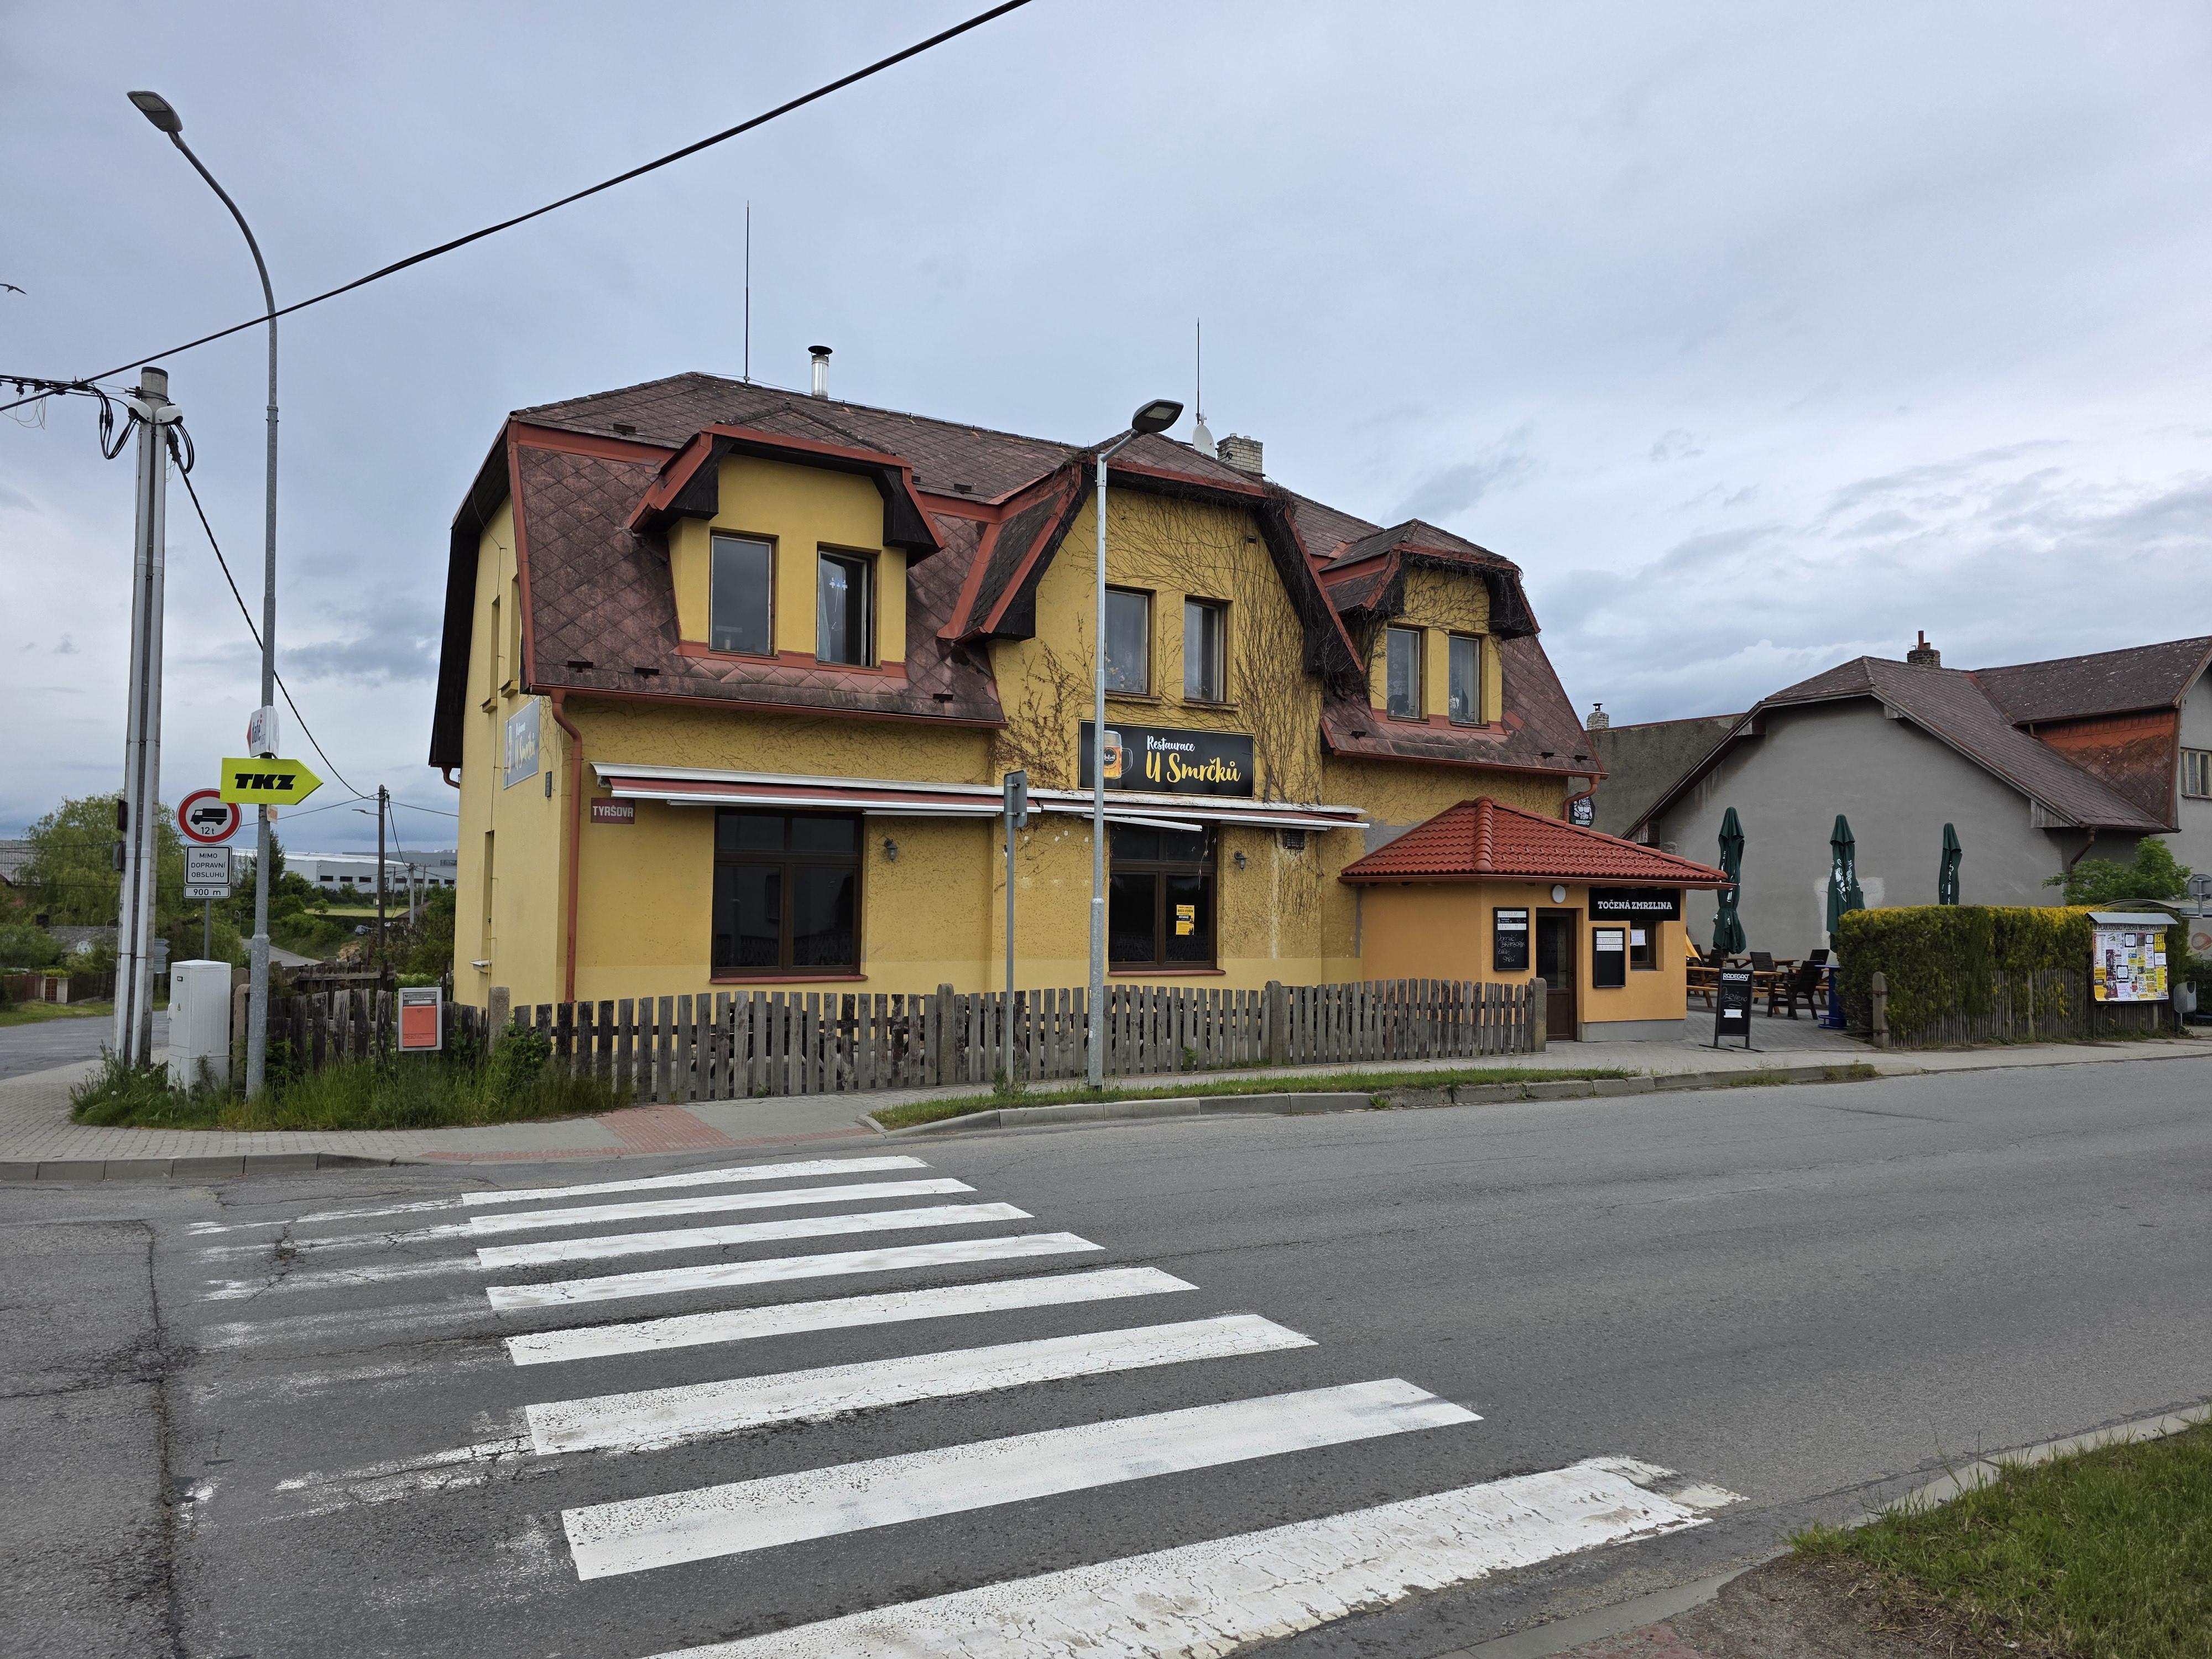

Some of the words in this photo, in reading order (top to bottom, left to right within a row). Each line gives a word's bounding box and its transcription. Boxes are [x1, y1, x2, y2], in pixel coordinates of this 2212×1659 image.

[1146, 735, 1196, 752] Restaurace
[1146, 750, 1160, 782] U
[1166, 752, 1241, 783] Smrčků
[234, 773, 296, 790] TKZ
[592, 805, 634, 817] TYRŠOVA
[1598, 899, 1631, 910] TOČENÁ
[1631, 901, 1672, 910] ZMRZLINA
[1723, 973, 1750, 982] RADEGAST
